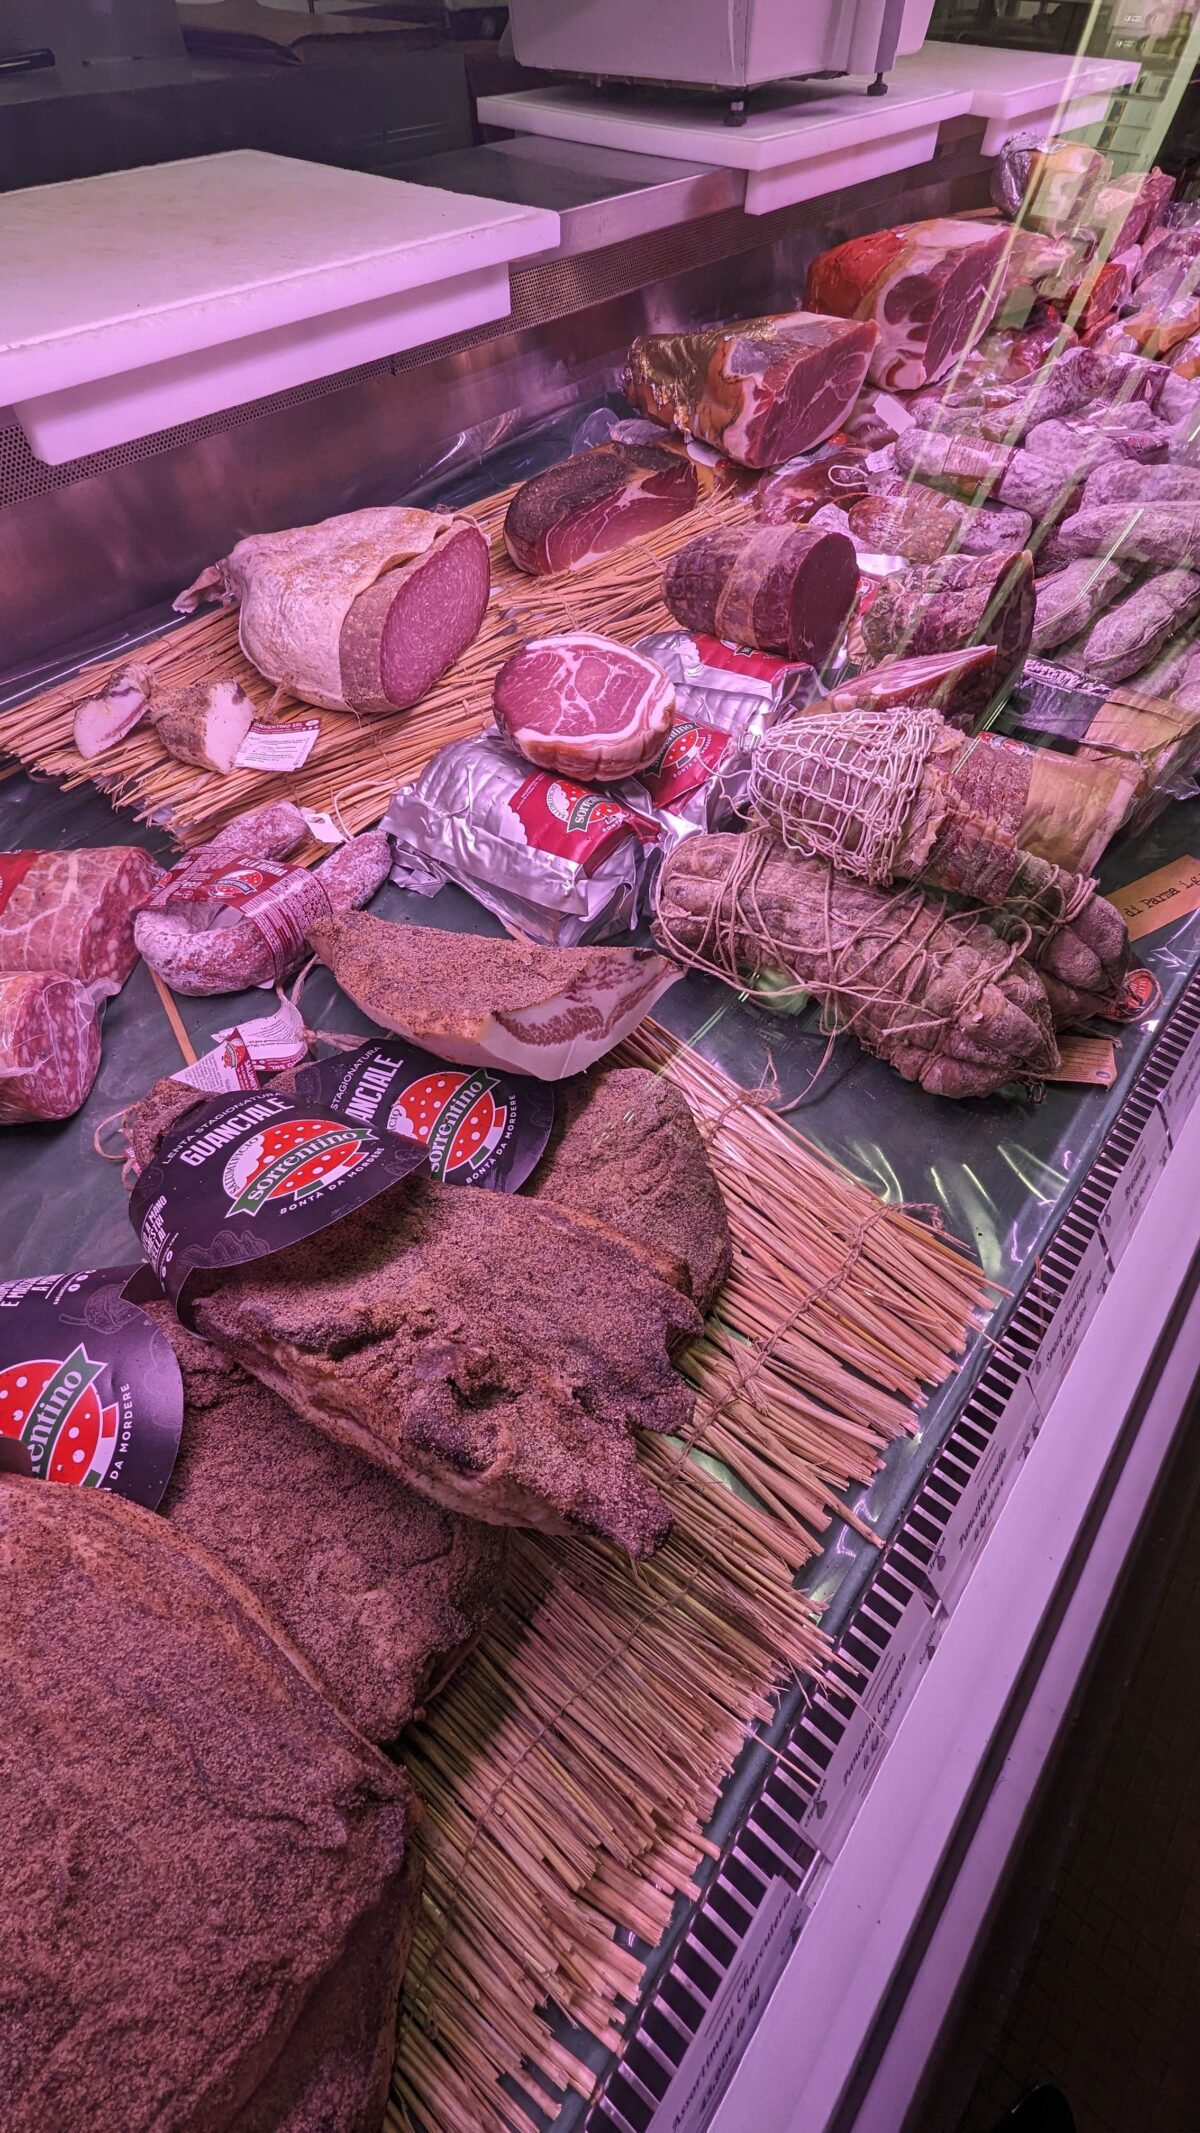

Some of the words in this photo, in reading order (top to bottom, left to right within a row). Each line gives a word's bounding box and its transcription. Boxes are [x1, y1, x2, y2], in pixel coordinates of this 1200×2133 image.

[548, 785, 567, 820] SALUMIFICIO
[575, 796, 598, 824] sorren
[1140, 888, 1181, 908] Parma
[331, 1046, 381, 1110] STAGIONATURA
[345, 1054, 404, 1123] ANCIALE
[162, 1131, 196, 1165] LENTA
[195, 1091, 283, 1135] STAGIONATURA
[179, 1097, 295, 1167] GUANCIALE
[429, 1081, 482, 1173] sorrentino
[496, 1142, 507, 1156] DA
[505, 1094, 517, 1138] MORDERE
[223, 1135, 259, 1195] SALUMIFICIO
[247, 1131, 359, 1201] sorrentino
[328, 1178, 347, 1192] DA
[349, 1147, 385, 1179] MORDERE
[148, 1195, 168, 1224] MANO
[28, 1370, 82, 1473] entino
[110, 1460, 124, 1480] DA
[119, 1383, 134, 1453] MORDERE
[843, 1716, 877, 1787] Pancetta
[877, 1652, 907, 1715] Coppata
[736, 2015, 746, 2039] le
[672, 2006, 735, 2132] Assortiment
